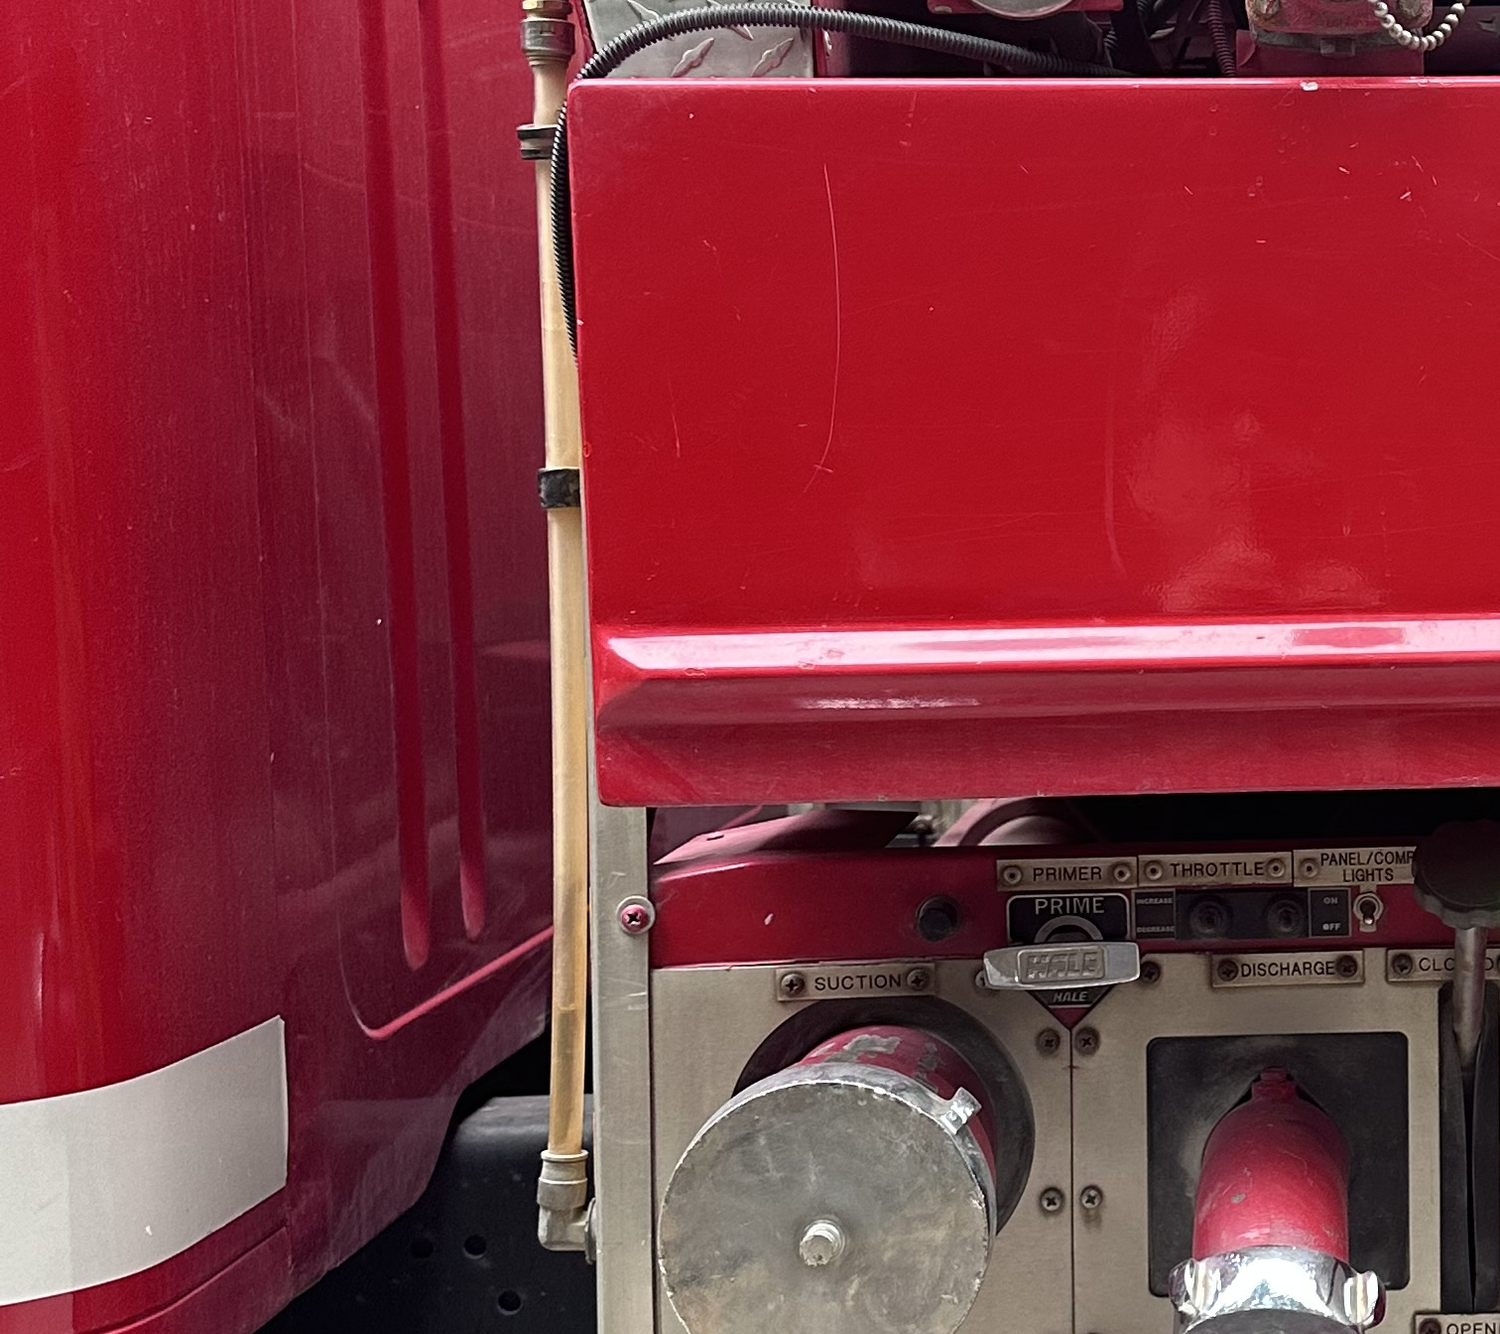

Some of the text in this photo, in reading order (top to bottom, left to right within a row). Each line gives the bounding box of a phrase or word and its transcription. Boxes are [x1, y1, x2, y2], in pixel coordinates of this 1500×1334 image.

[1033, 867, 1102, 882] PRIMER
[1171, 861, 1265, 878] THROTTLE
[1343, 868, 1394, 883] LIGHTS
[1035, 897, 1105, 915] PRIME
[1323, 897, 1338, 905] ON
[1322, 923, 1341, 931] OFF
[1027, 952, 1098, 979] HALE
[1241, 961, 1336, 978] DISCHARGE
[1419, 957, 1494, 971] CLOD
[814, 974, 901, 991] SUCTION
[1053, 991, 1089, 1003] HALE
